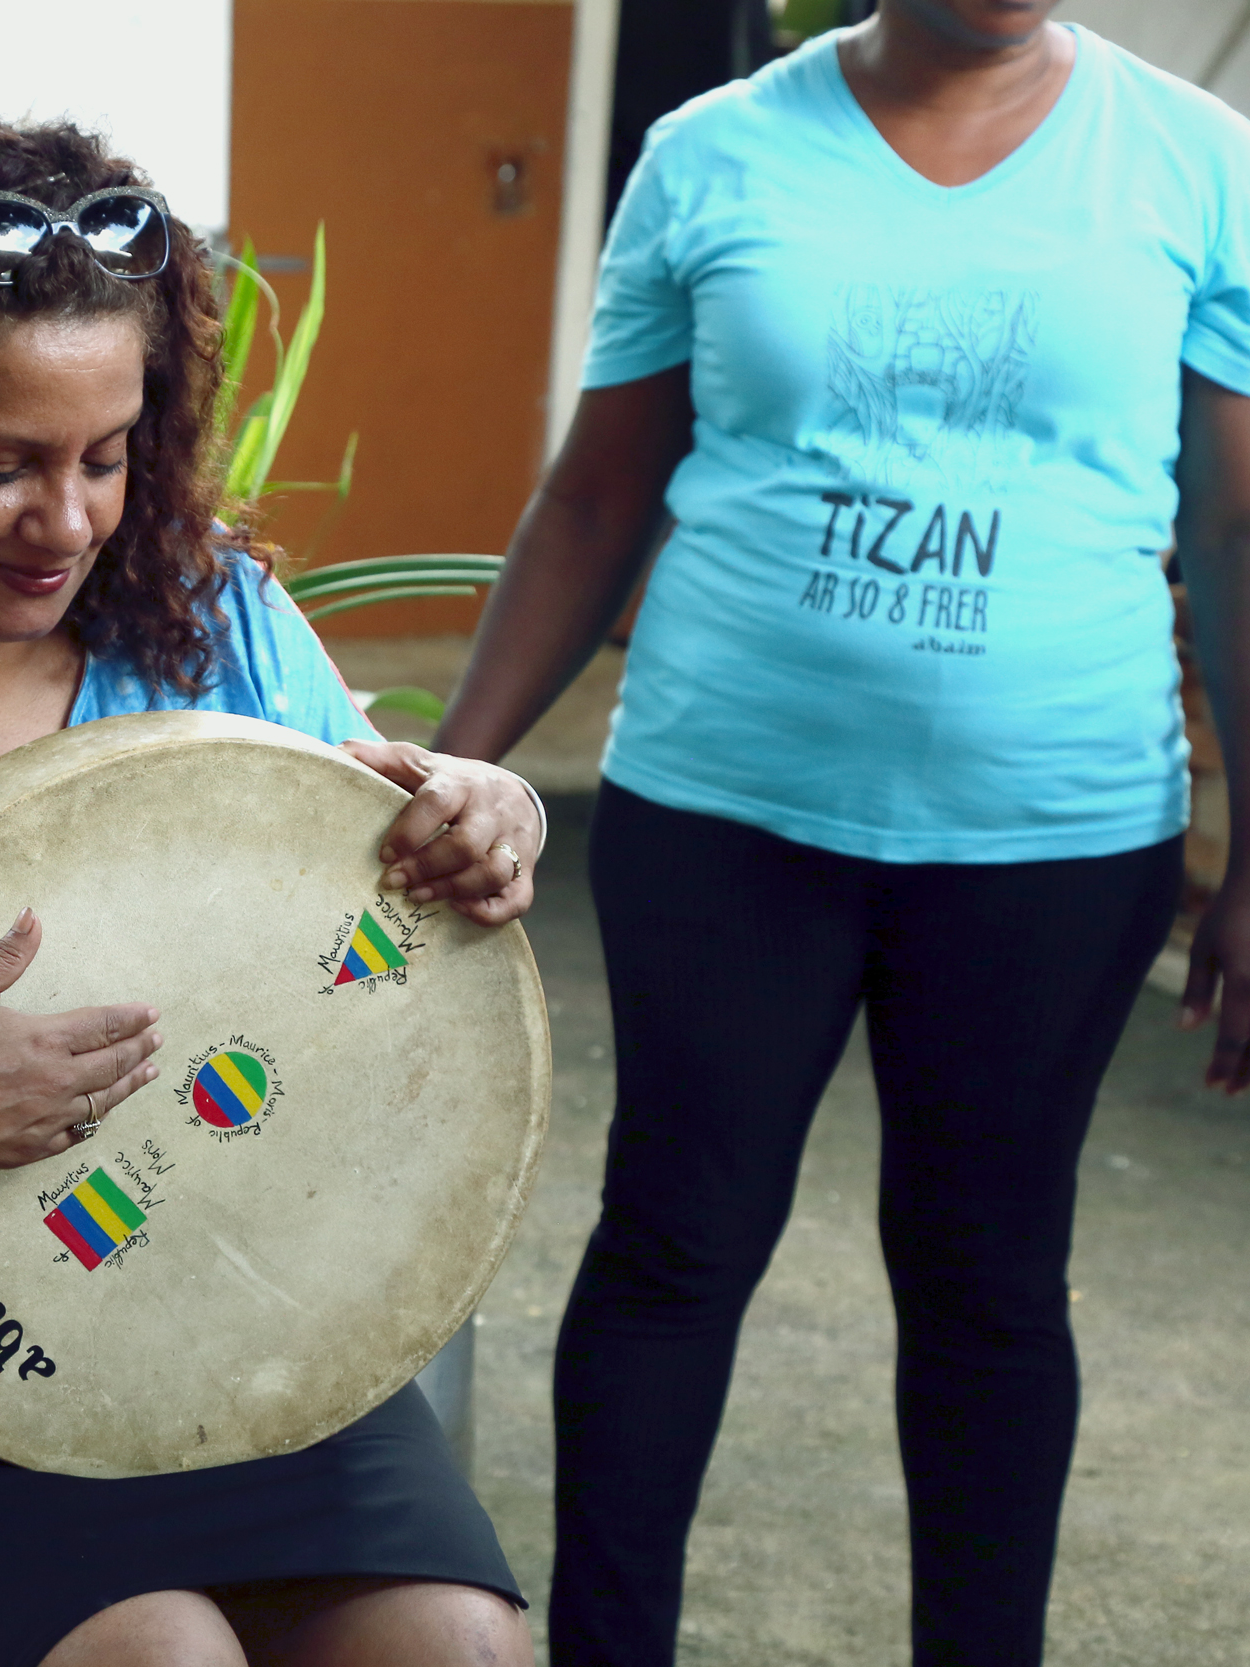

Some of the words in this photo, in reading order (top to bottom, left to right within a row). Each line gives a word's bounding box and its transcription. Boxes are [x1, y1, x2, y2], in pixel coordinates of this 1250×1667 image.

[799, 570, 839, 614] AR
[842, 574, 881, 620] SO
[917, 584, 988, 633] FRER
[375, 893, 426, 953] Maurice
[317, 912, 355, 975] Mauritius
[317, 983, 335, 996] of
[358, 965, 408, 995] Republic
[229, 1034, 276, 1066] Maurice
[173, 1045, 218, 1105] Mauritius
[262, 1080, 286, 1118] Moris
[184, 1114, 202, 1127] of
[208, 1121, 262, 1144] Republic
[141, 1139, 176, 1176] Moris
[37, 1162, 90, 1212] Mauritius
[114, 1151, 167, 1211] Maurice
[104, 1229, 151, 1270] Republic
